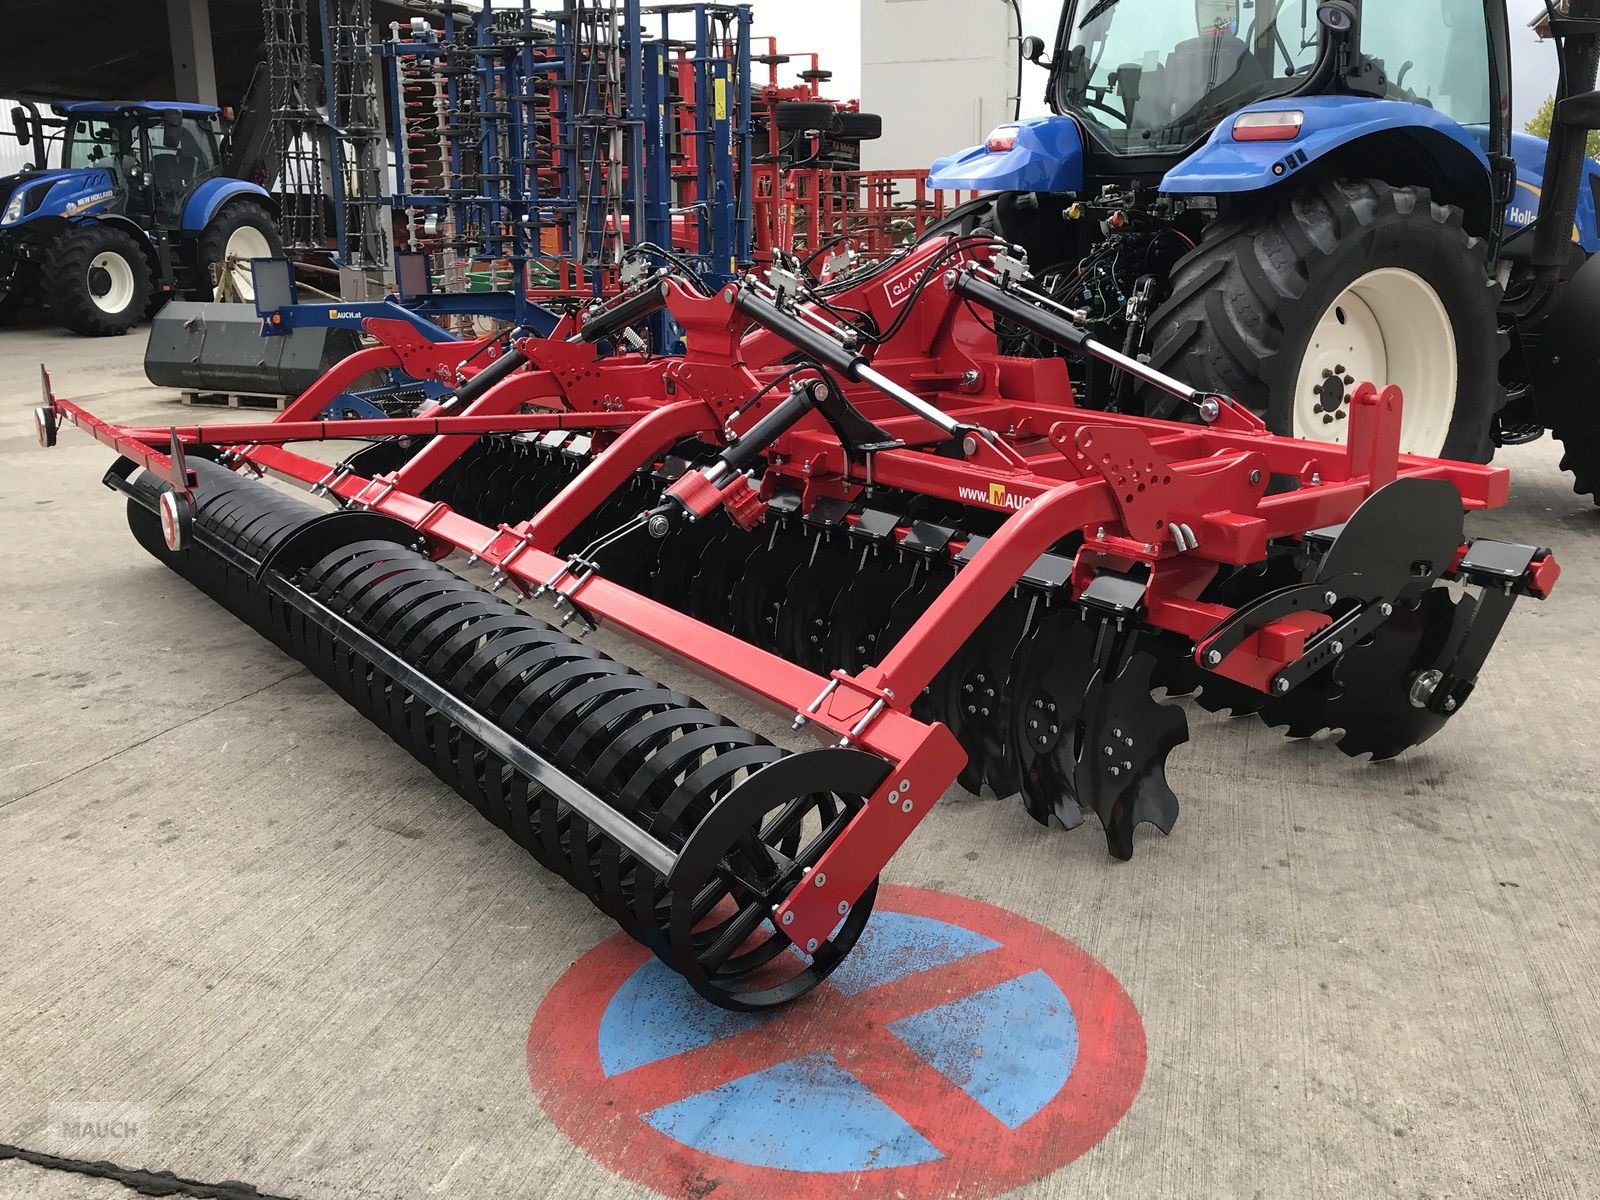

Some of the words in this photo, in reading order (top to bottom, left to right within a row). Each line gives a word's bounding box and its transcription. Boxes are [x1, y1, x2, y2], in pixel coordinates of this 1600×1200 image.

[77, 196, 90, 206] NEW
[90, 190, 113, 201] HOLLAND
[1510, 206, 1537, 225] Holla
[958, 485, 1035, 510] www.MAUC
